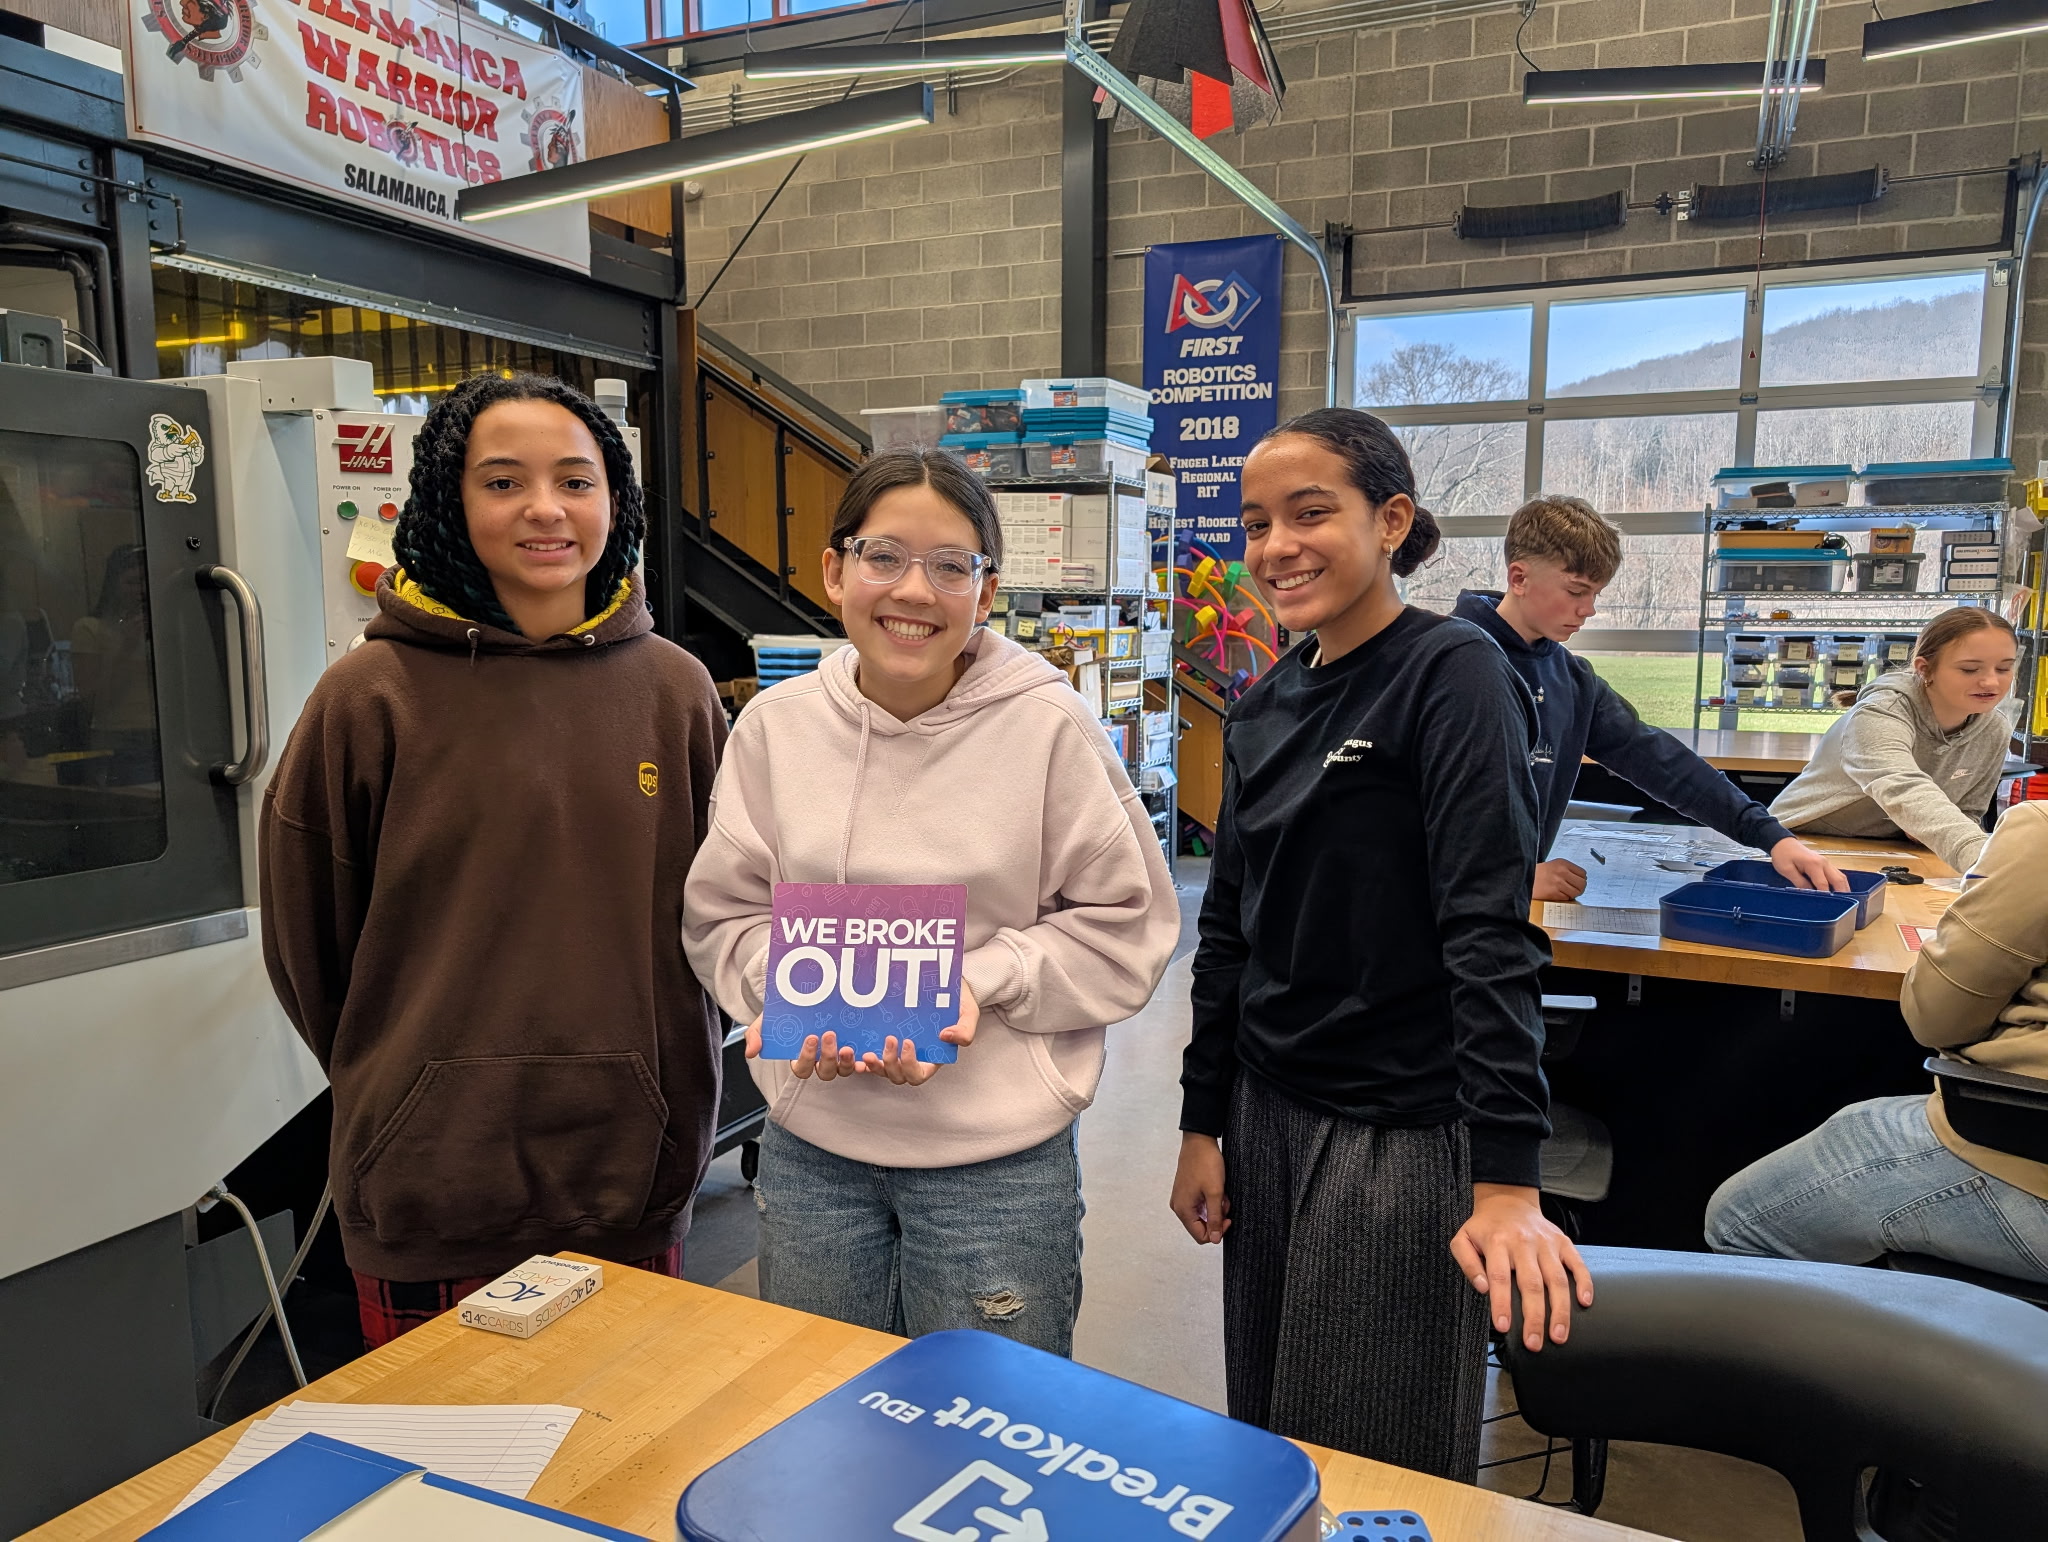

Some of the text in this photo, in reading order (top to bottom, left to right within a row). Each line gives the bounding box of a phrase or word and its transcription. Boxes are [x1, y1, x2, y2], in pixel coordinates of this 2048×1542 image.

[288, 0, 527, 100] LAMANCA
[297, 19, 500, 142] WARRIOR
[305, 81, 503, 186] ROBOTICS
[344, 163, 451, 220] SALAMANCA,
[1180, 336, 1243, 358] FIRST
[1163, 364, 1257, 386] ROBOTICS
[1150, 382, 1273, 405] COMPETITION
[1180, 416, 1240, 441] 2018
[340, 455, 392, 469] HAAS
[1170, 456, 1209, 469] FINGER
[1181, 471, 1236, 484] REGIONAL
[1196, 485, 1220, 498] RIT
[1148, 517, 1194, 530] HIGEST
[1197, 515, 1238, 528] ROOKIE
[1195, 531, 1231, 543] WARD
[641, 771, 657, 791] ups
[780, 917, 957, 945] WE BROKE
[775, 946, 954, 1008] OUT!
[507, 1269, 571, 1287] CARDS
[486, 1281, 546, 1302] 4C
[535, 1286, 584, 1328] 4C CARDS
[473, 1313, 524, 1332] 4C CARDS
[858, 1390, 1235, 1542] Breakout EDU
